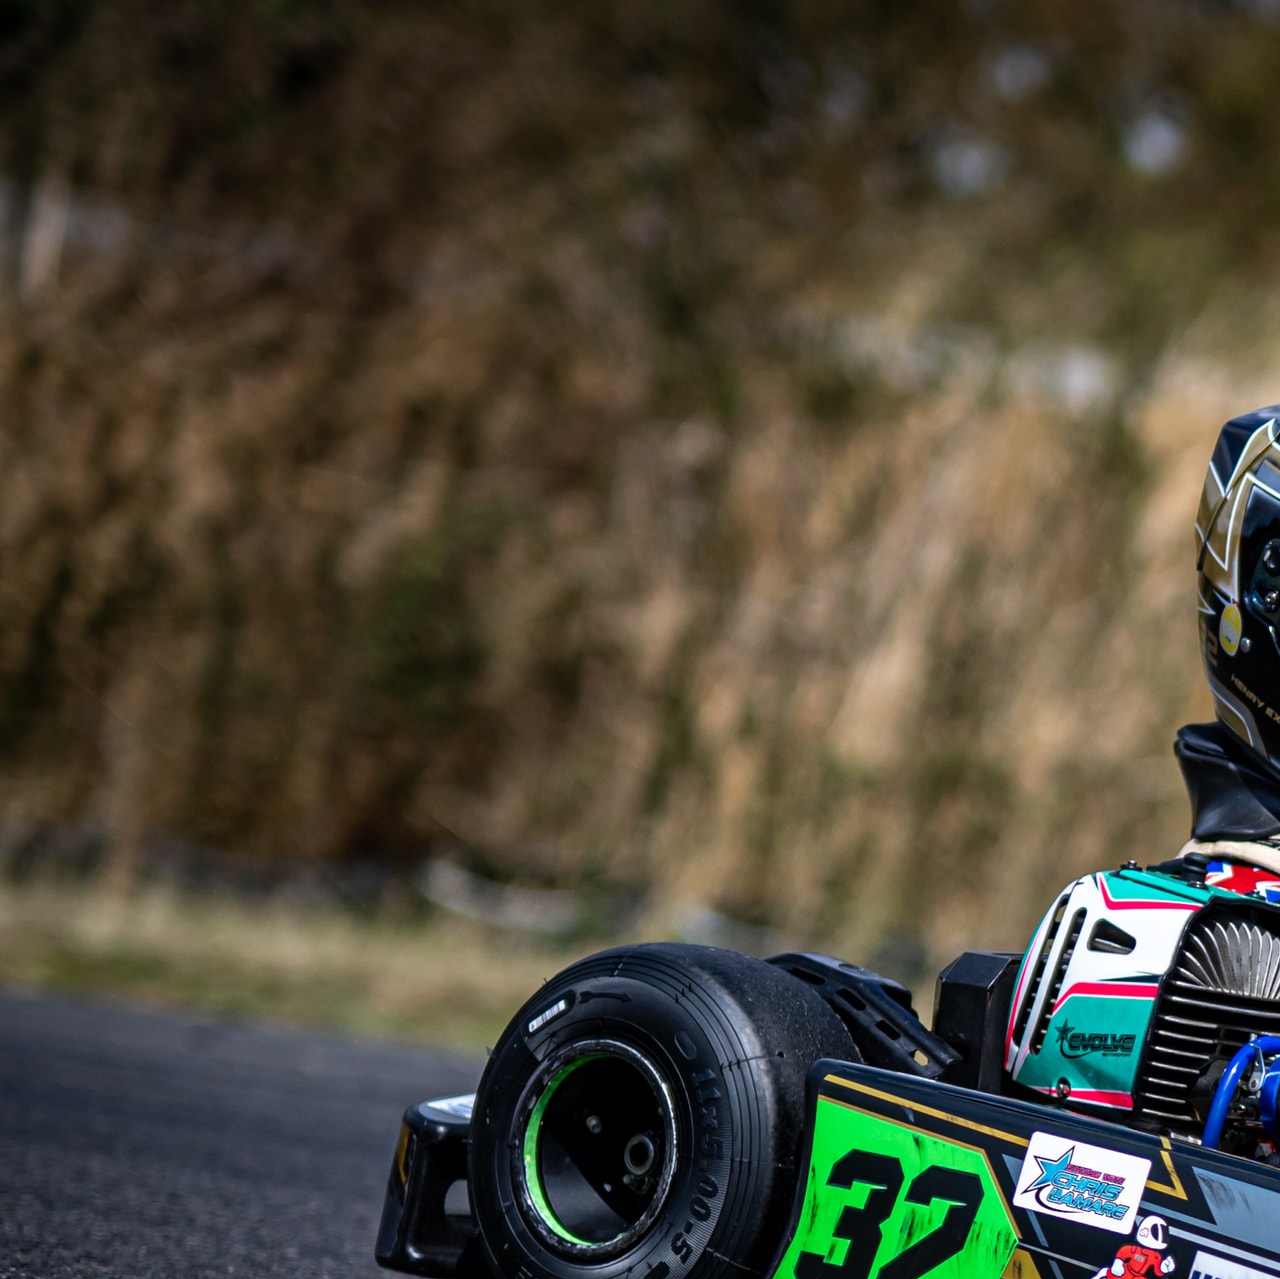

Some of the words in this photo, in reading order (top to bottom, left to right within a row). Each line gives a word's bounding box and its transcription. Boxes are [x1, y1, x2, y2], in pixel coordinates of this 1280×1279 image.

[1231, 673, 1265, 707] HENRY
[1068, 1033, 1136, 1053] EVOLVE
[1051, 1171, 1125, 1201] CHRIS
[1047, 1187, 1130, 1220] LAMARE
